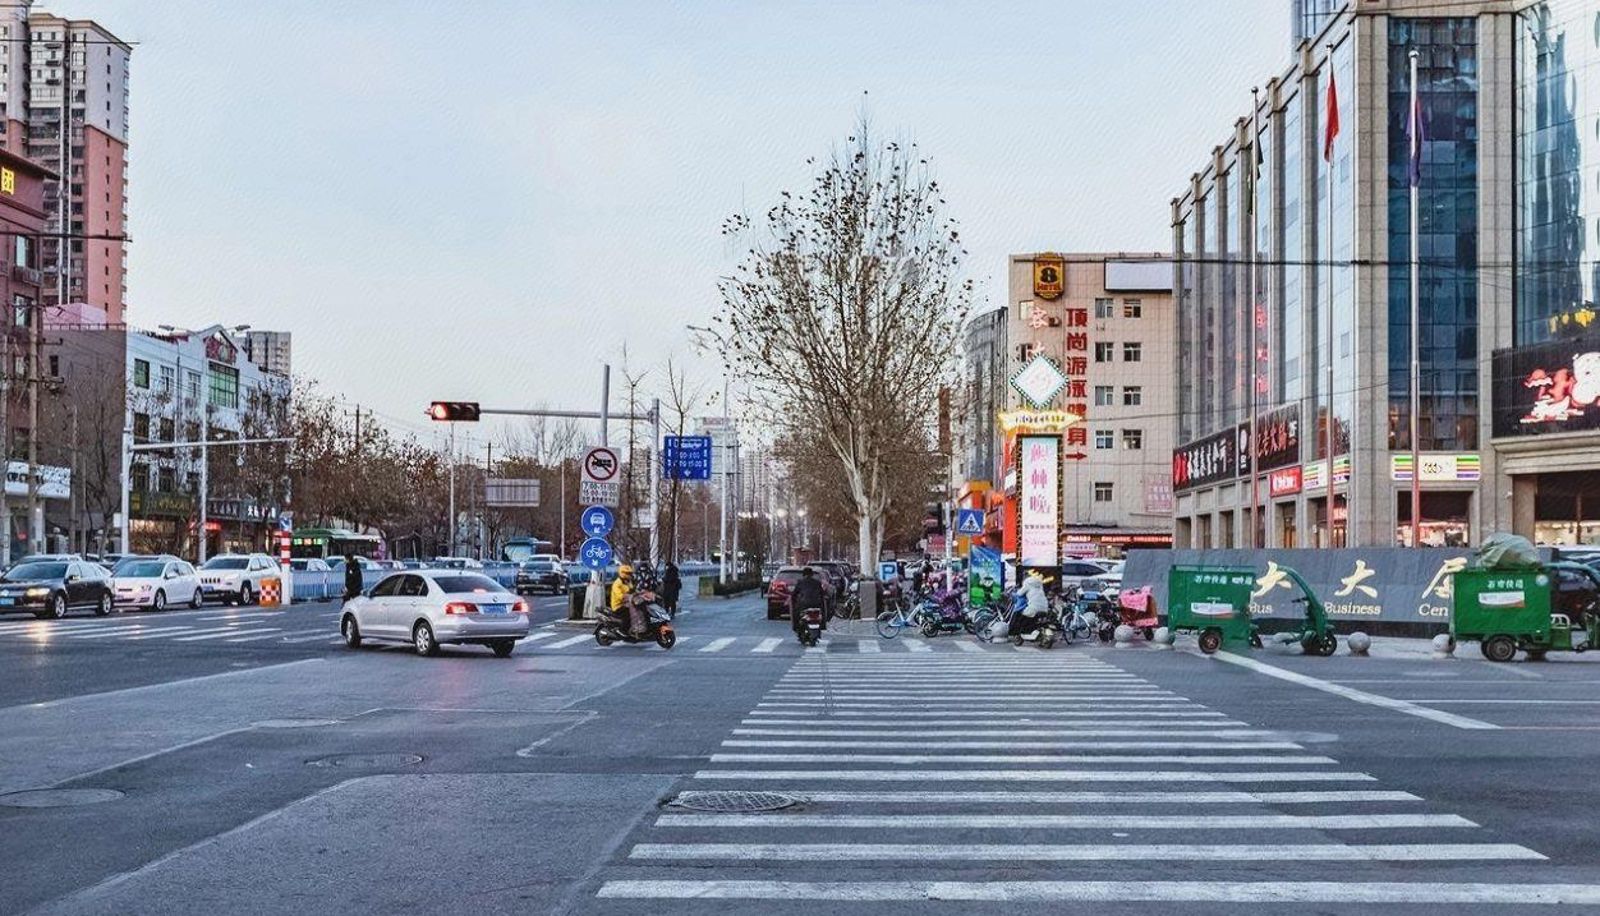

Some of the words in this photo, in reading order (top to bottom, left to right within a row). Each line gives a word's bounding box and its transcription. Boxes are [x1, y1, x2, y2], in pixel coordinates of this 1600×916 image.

[1039, 267, 1058, 283] 8
[882, 564, 895, 580] P
[1323, 601, 1382, 615] Business
